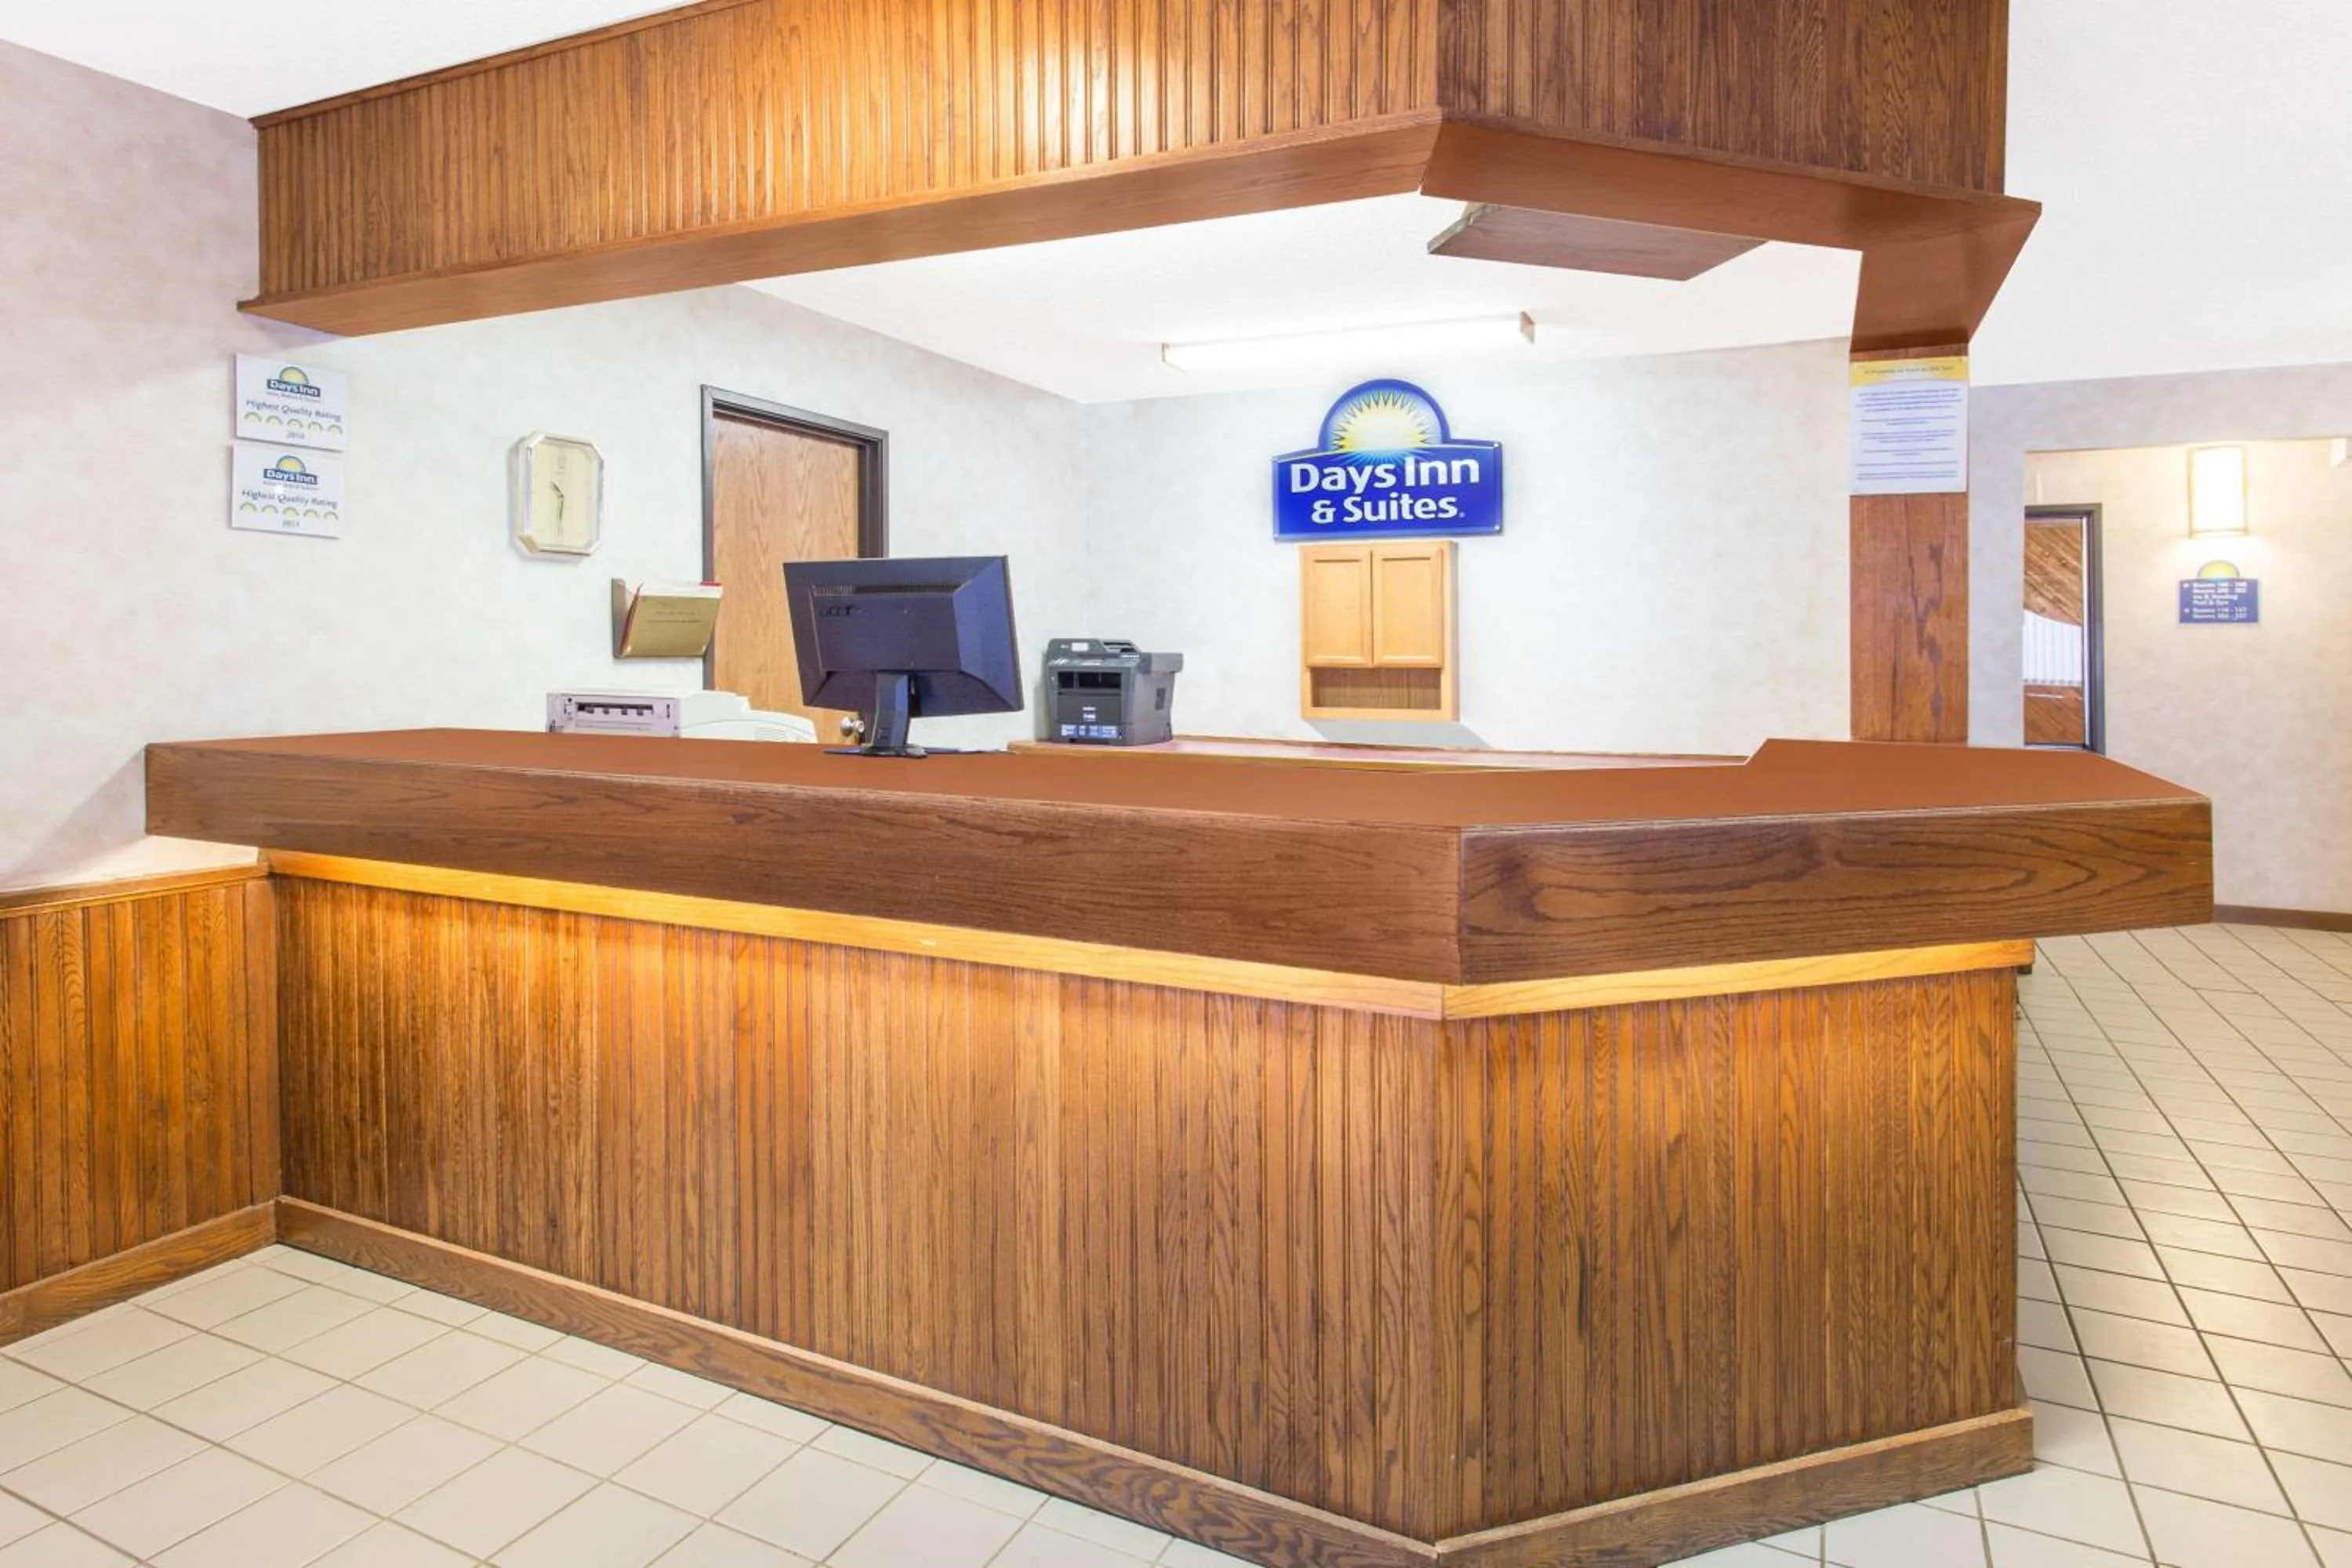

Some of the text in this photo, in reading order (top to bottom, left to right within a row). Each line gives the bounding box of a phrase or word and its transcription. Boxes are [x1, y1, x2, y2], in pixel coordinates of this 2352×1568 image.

[270, 379, 318, 397] Days Inn
[245, 398, 342, 422] Highest Quality Rating
[267, 470, 315, 485] Days Inn
[1290, 457, 1480, 495] Days Inn
[278, 493, 309, 506] Quality
[1311, 492, 1458, 524] & Suites
